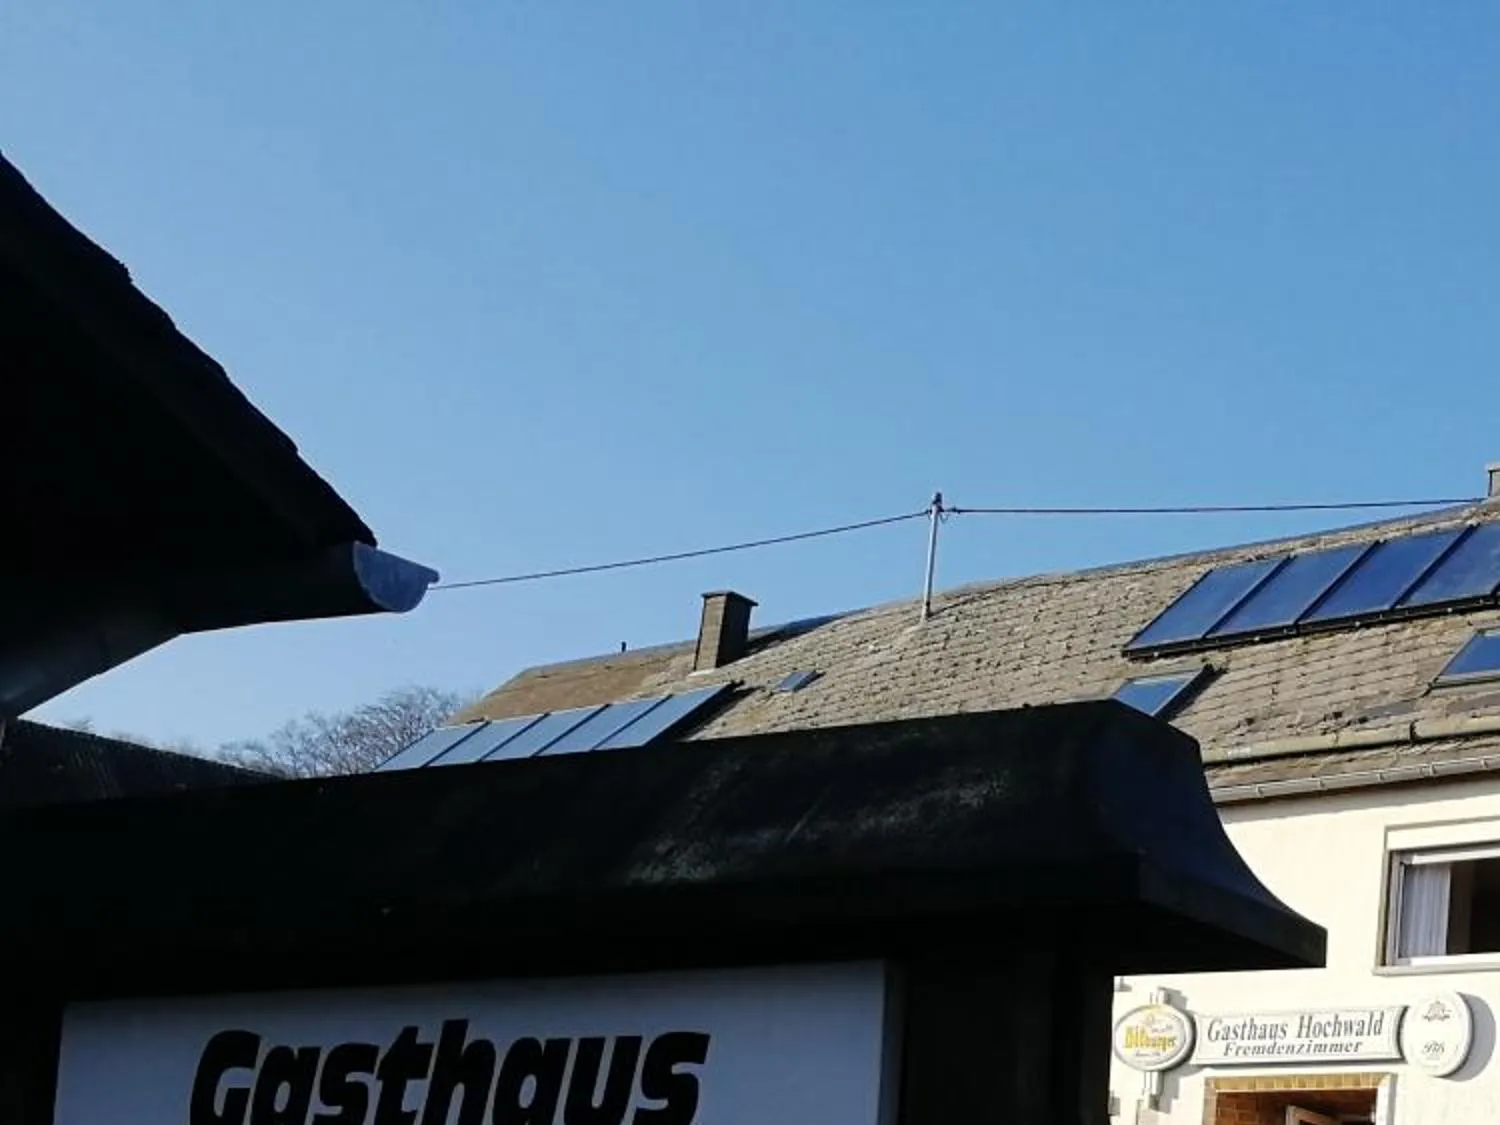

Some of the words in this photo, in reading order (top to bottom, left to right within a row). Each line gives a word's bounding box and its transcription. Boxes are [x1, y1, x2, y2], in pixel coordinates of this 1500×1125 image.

[1207, 1017, 1288, 1044] Gasthaus
[1296, 1010, 1384, 1041] Hochwald
[1223, 1040, 1362, 1057] Fremdenzimmer
